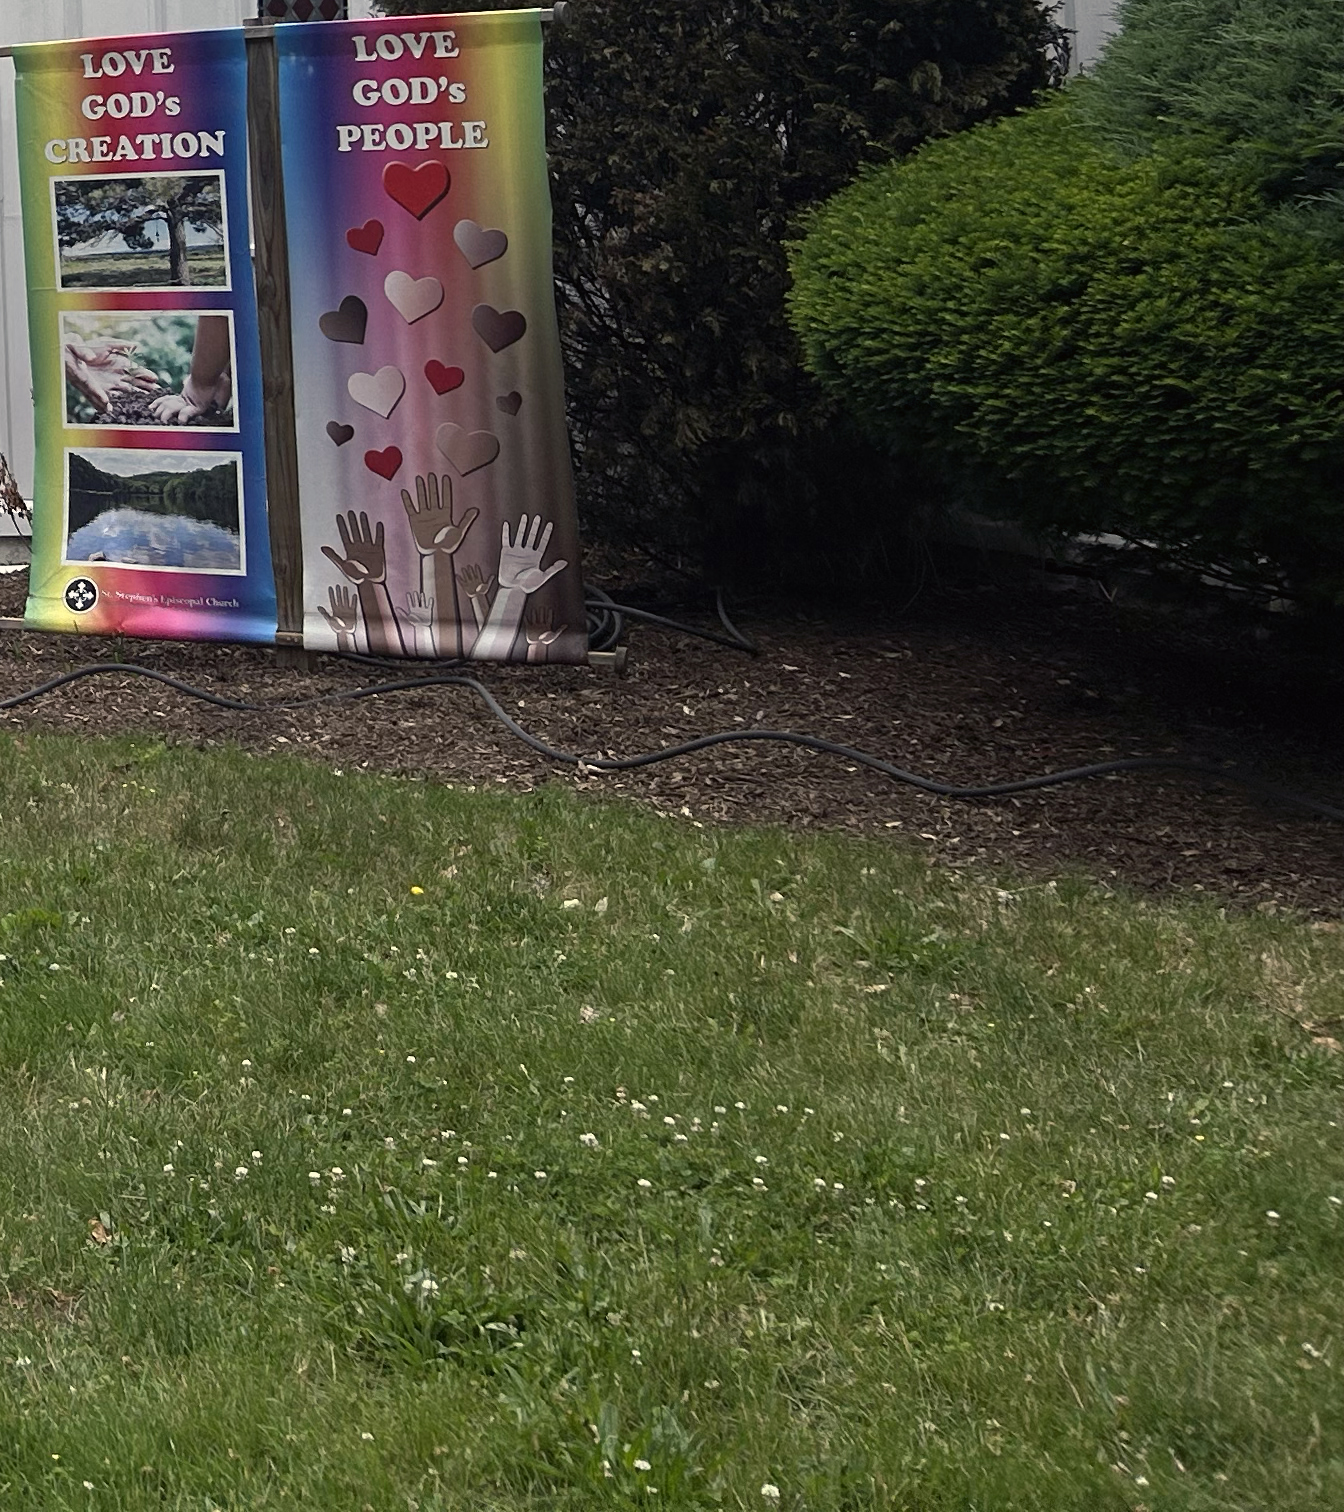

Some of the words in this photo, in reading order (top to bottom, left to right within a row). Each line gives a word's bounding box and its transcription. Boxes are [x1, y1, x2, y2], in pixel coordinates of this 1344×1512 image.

[351, 31, 460, 62] LOVE
[80, 48, 175, 79] LOVE
[81, 91, 181, 120] GOD's
[352, 76, 467, 107] GOD's
[44, 130, 226, 164] CREATION
[336, 120, 489, 152] PEOPLE
[115, 590, 159, 604] Stephen's
[160, 594, 204, 608] Episcopal
[205, 597, 240, 609] Church
